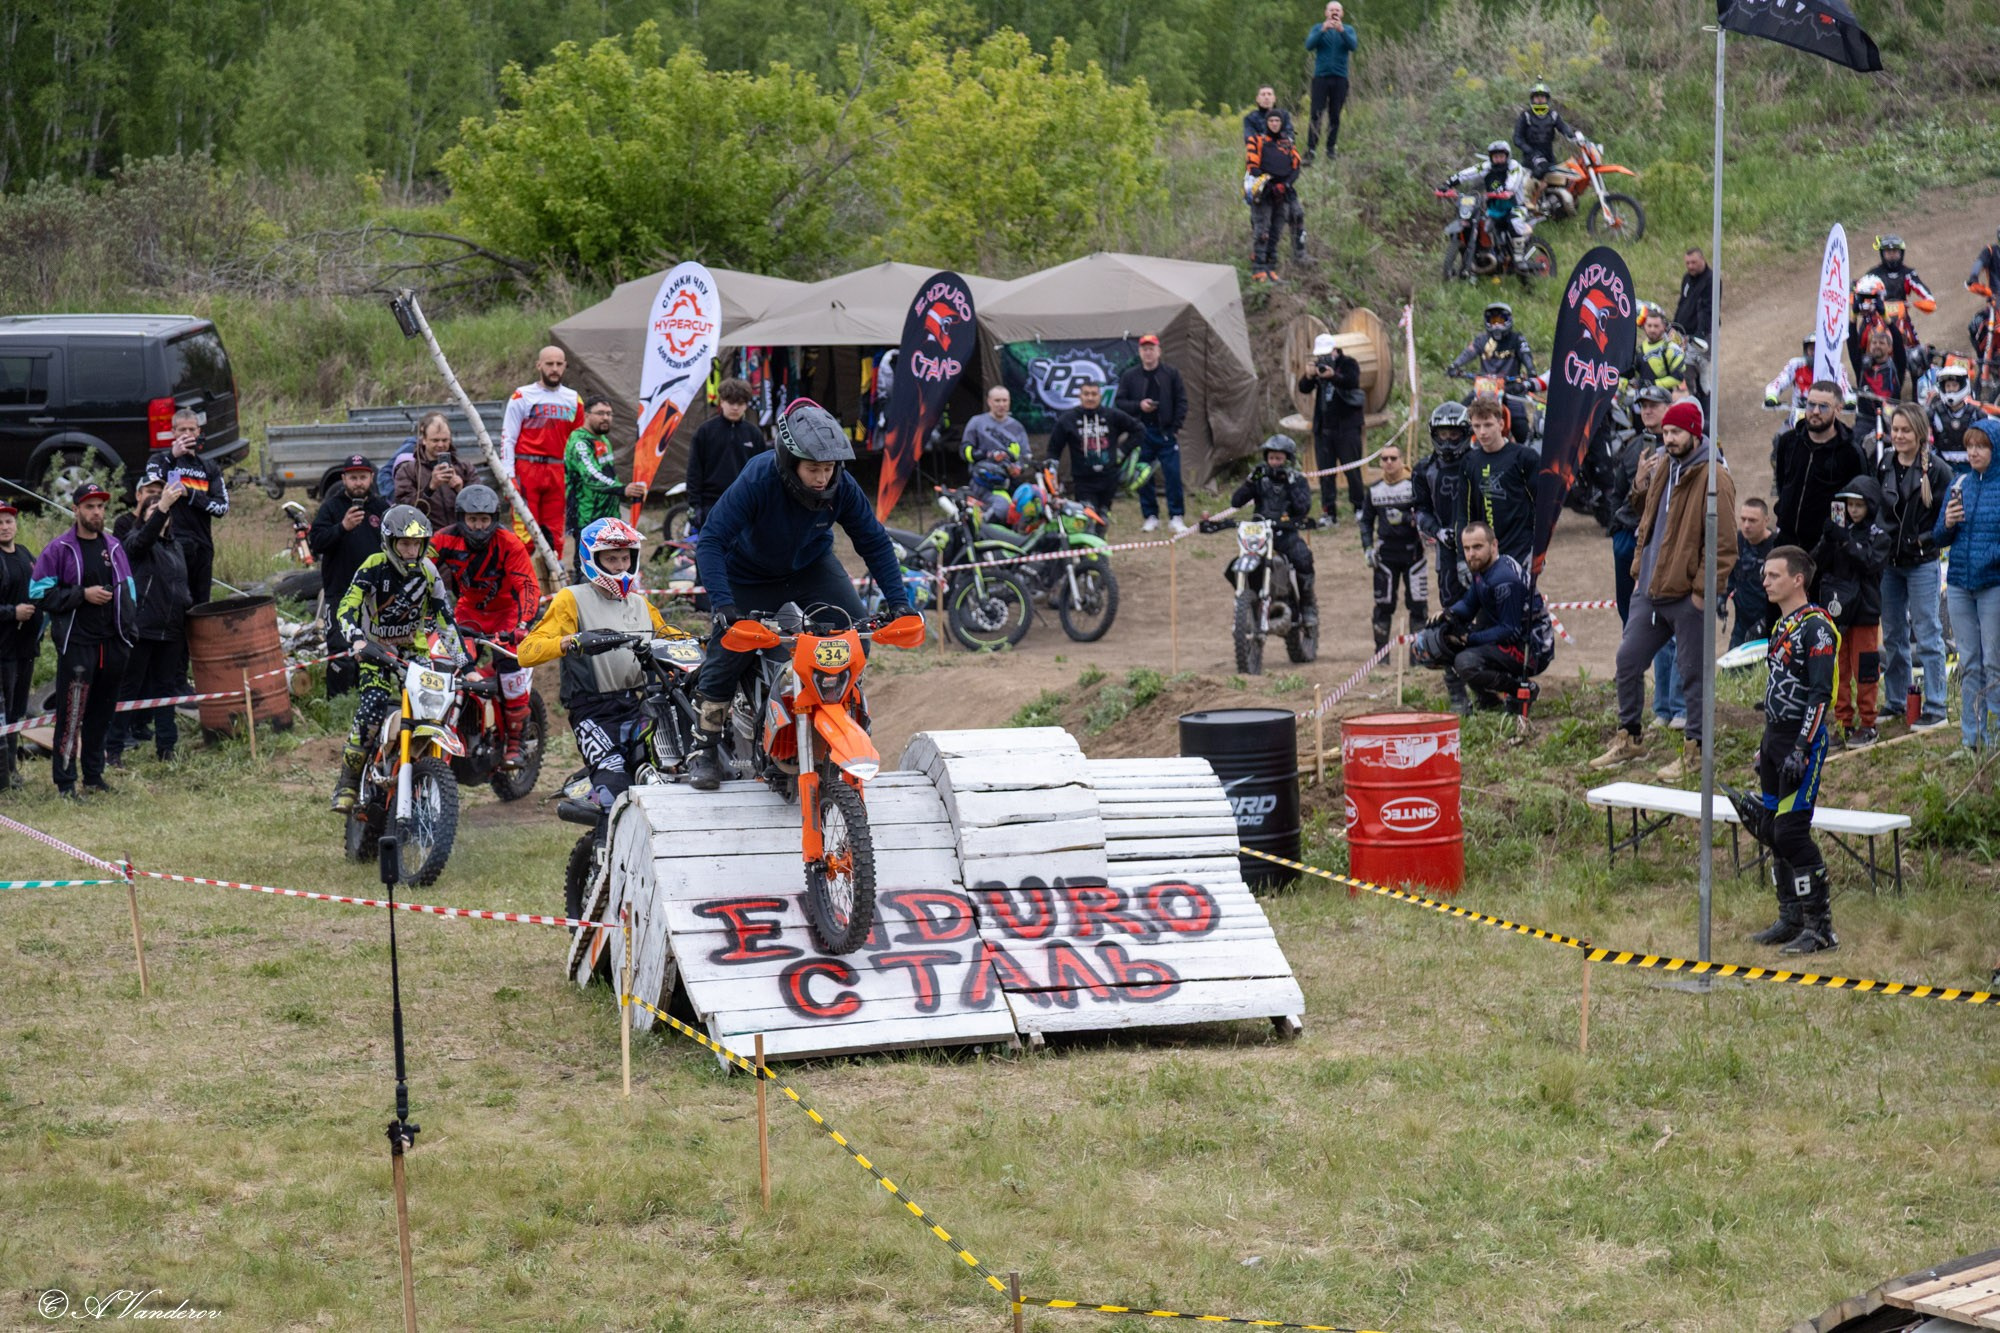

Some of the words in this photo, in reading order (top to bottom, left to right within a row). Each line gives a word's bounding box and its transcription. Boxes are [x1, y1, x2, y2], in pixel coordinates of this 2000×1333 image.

[662, 275, 692, 309] СТАНКИ
[693, 275, 709, 296] ЧПУ
[1567, 263, 1631, 319] ENDURO
[654, 319, 714, 334] HYPERCUT
[534, 404, 571, 417] LEATT
[778, 417, 797, 452] 100%
[825, 649, 842, 661] 34
[426, 676, 439, 688] 94
[1382, 806, 1438, 821] SINTEC
[693, 876, 1222, 965] EDURO
[777, 939, 1182, 1020] СТАЛЬ
